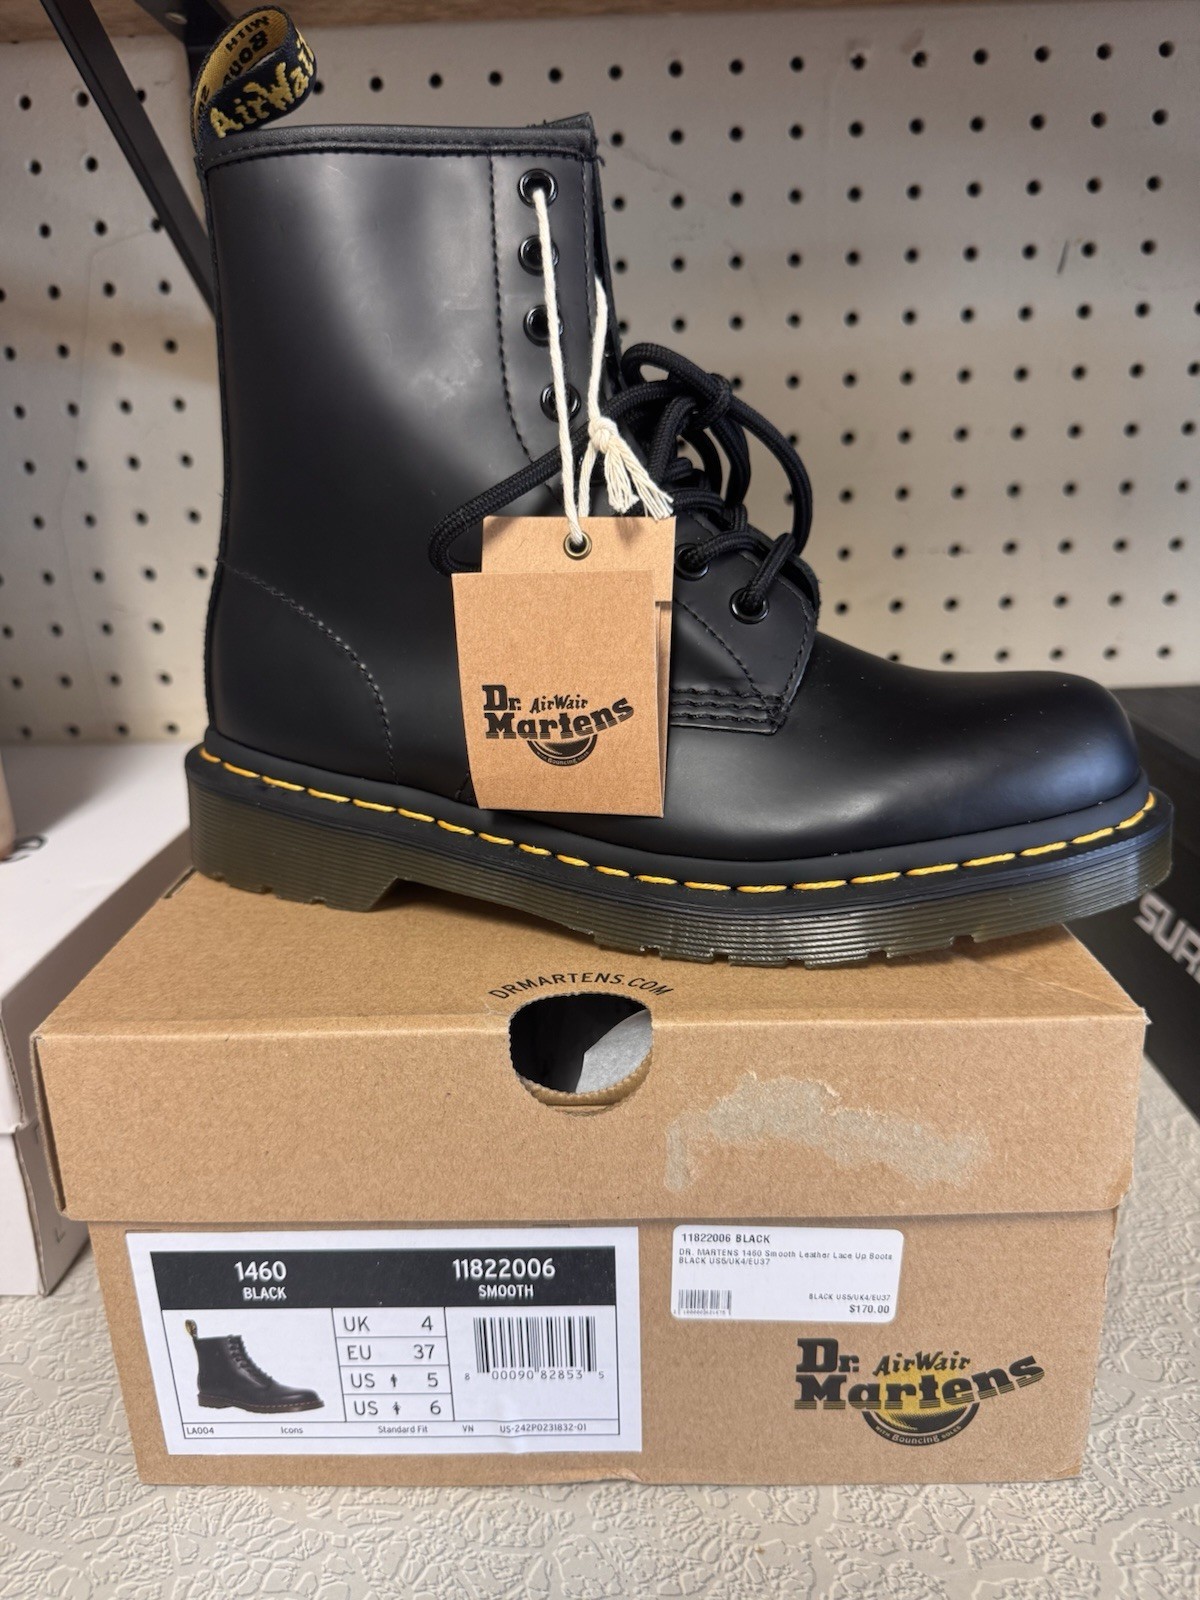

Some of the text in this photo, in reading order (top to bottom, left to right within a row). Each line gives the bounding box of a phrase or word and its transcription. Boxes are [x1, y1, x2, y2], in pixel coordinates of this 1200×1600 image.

[481, 684, 522, 711] Dr.
[529, 694, 589, 714] AirWair
[483, 697, 635, 740] Martens
[1132, 889, 1200, 986] SUR
[487, 972, 675, 1000] DRMARTENS.COM
[682, 1233, 771, 1244] 11822006 BLACK
[678, 1248, 695, 1257] DR.
[697, 1248, 739, 1257] MARTENS
[765, 1249, 796, 1258] Smooth
[799, 1251, 830, 1259] Leather
[833, 1251, 853, 1260] Lace
[855, 1252, 867, 1262] Up
[869, 1252, 893, 1261] Boots
[678, 1256, 771, 1266] BLACK US5/UK4/EU37
[234, 1260, 288, 1282] 1460
[452, 1257, 556, 1281] 11822006
[242, 1286, 288, 1301] BLACK
[477, 1283, 535, 1299] SMOOTH
[809, 1292, 891, 1302] BLACK US5/UK4/EU37
[849, 1304, 890, 1314] $170.00
[343, 1315, 434, 1333] UK 4
[347, 1344, 435, 1361] EU 37
[796, 1337, 860, 1373] Dr.
[872, 1350, 971, 1377] AirWair
[350, 1372, 439, 1389] US 5
[464, 1372, 471, 1381] 8
[540, 1369, 584, 1380] 82853
[598, 1370, 605, 1380] 5
[794, 1355, 1046, 1410] Martens
[354, 1400, 442, 1416] US 6
[186, 1426, 215, 1436] LA004
[281, 1426, 304, 1435] Icons
[377, 1424, 429, 1434] Standard Fit
[462, 1424, 475, 1433] VN
[891, 1434, 941, 1446] Bouncing
[941, 1424, 963, 1440] SOLES
